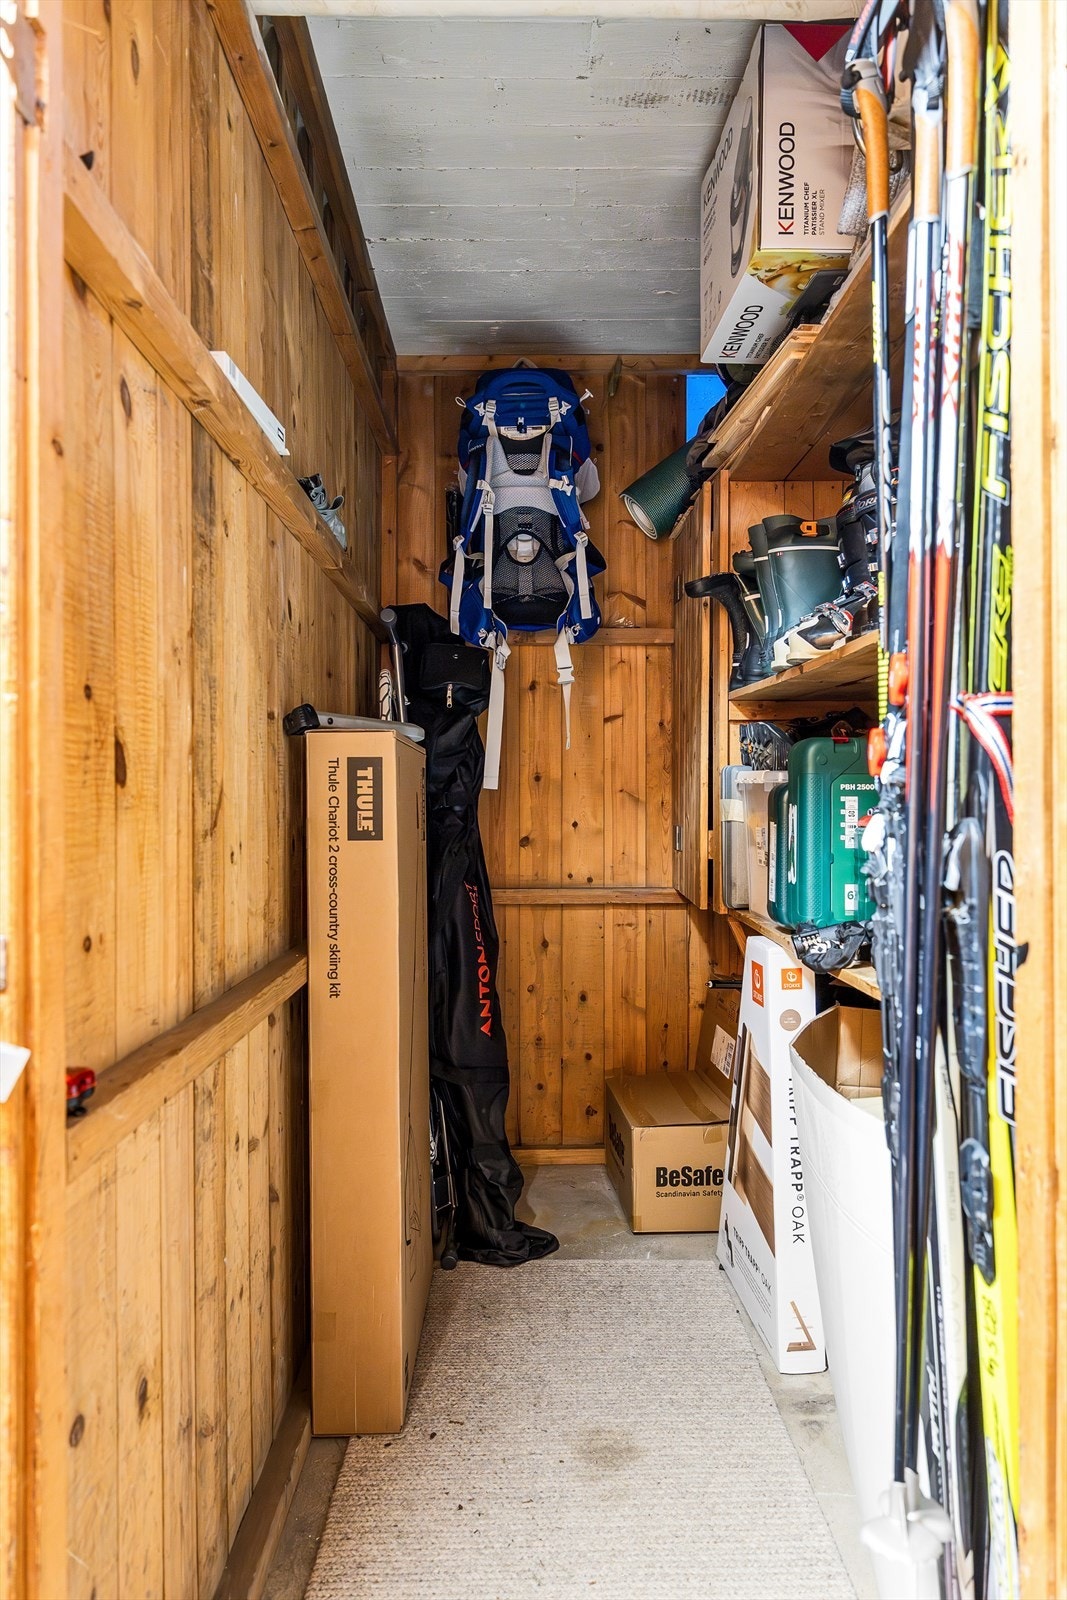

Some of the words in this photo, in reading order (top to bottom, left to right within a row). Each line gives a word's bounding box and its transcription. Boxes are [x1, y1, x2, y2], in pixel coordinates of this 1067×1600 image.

[778, 121, 796, 235] KENWOOD
[811, 190, 818, 198] XL
[719, 305, 764, 358] KENWOOD
[328, 757, 340, 793] Thule
[840, 783, 856, 791] PBH
[328, 796, 340, 842] Chariot
[328, 844, 340, 853] 2
[327, 855, 340, 941] cross-country
[327, 943, 341, 980] skiing
[329, 983, 341, 999] kit
[655, 1165, 724, 1188] BeSafe
[655, 1190, 701, 1198] Scandinavian
[791, 1205, 805, 1245] OAK
